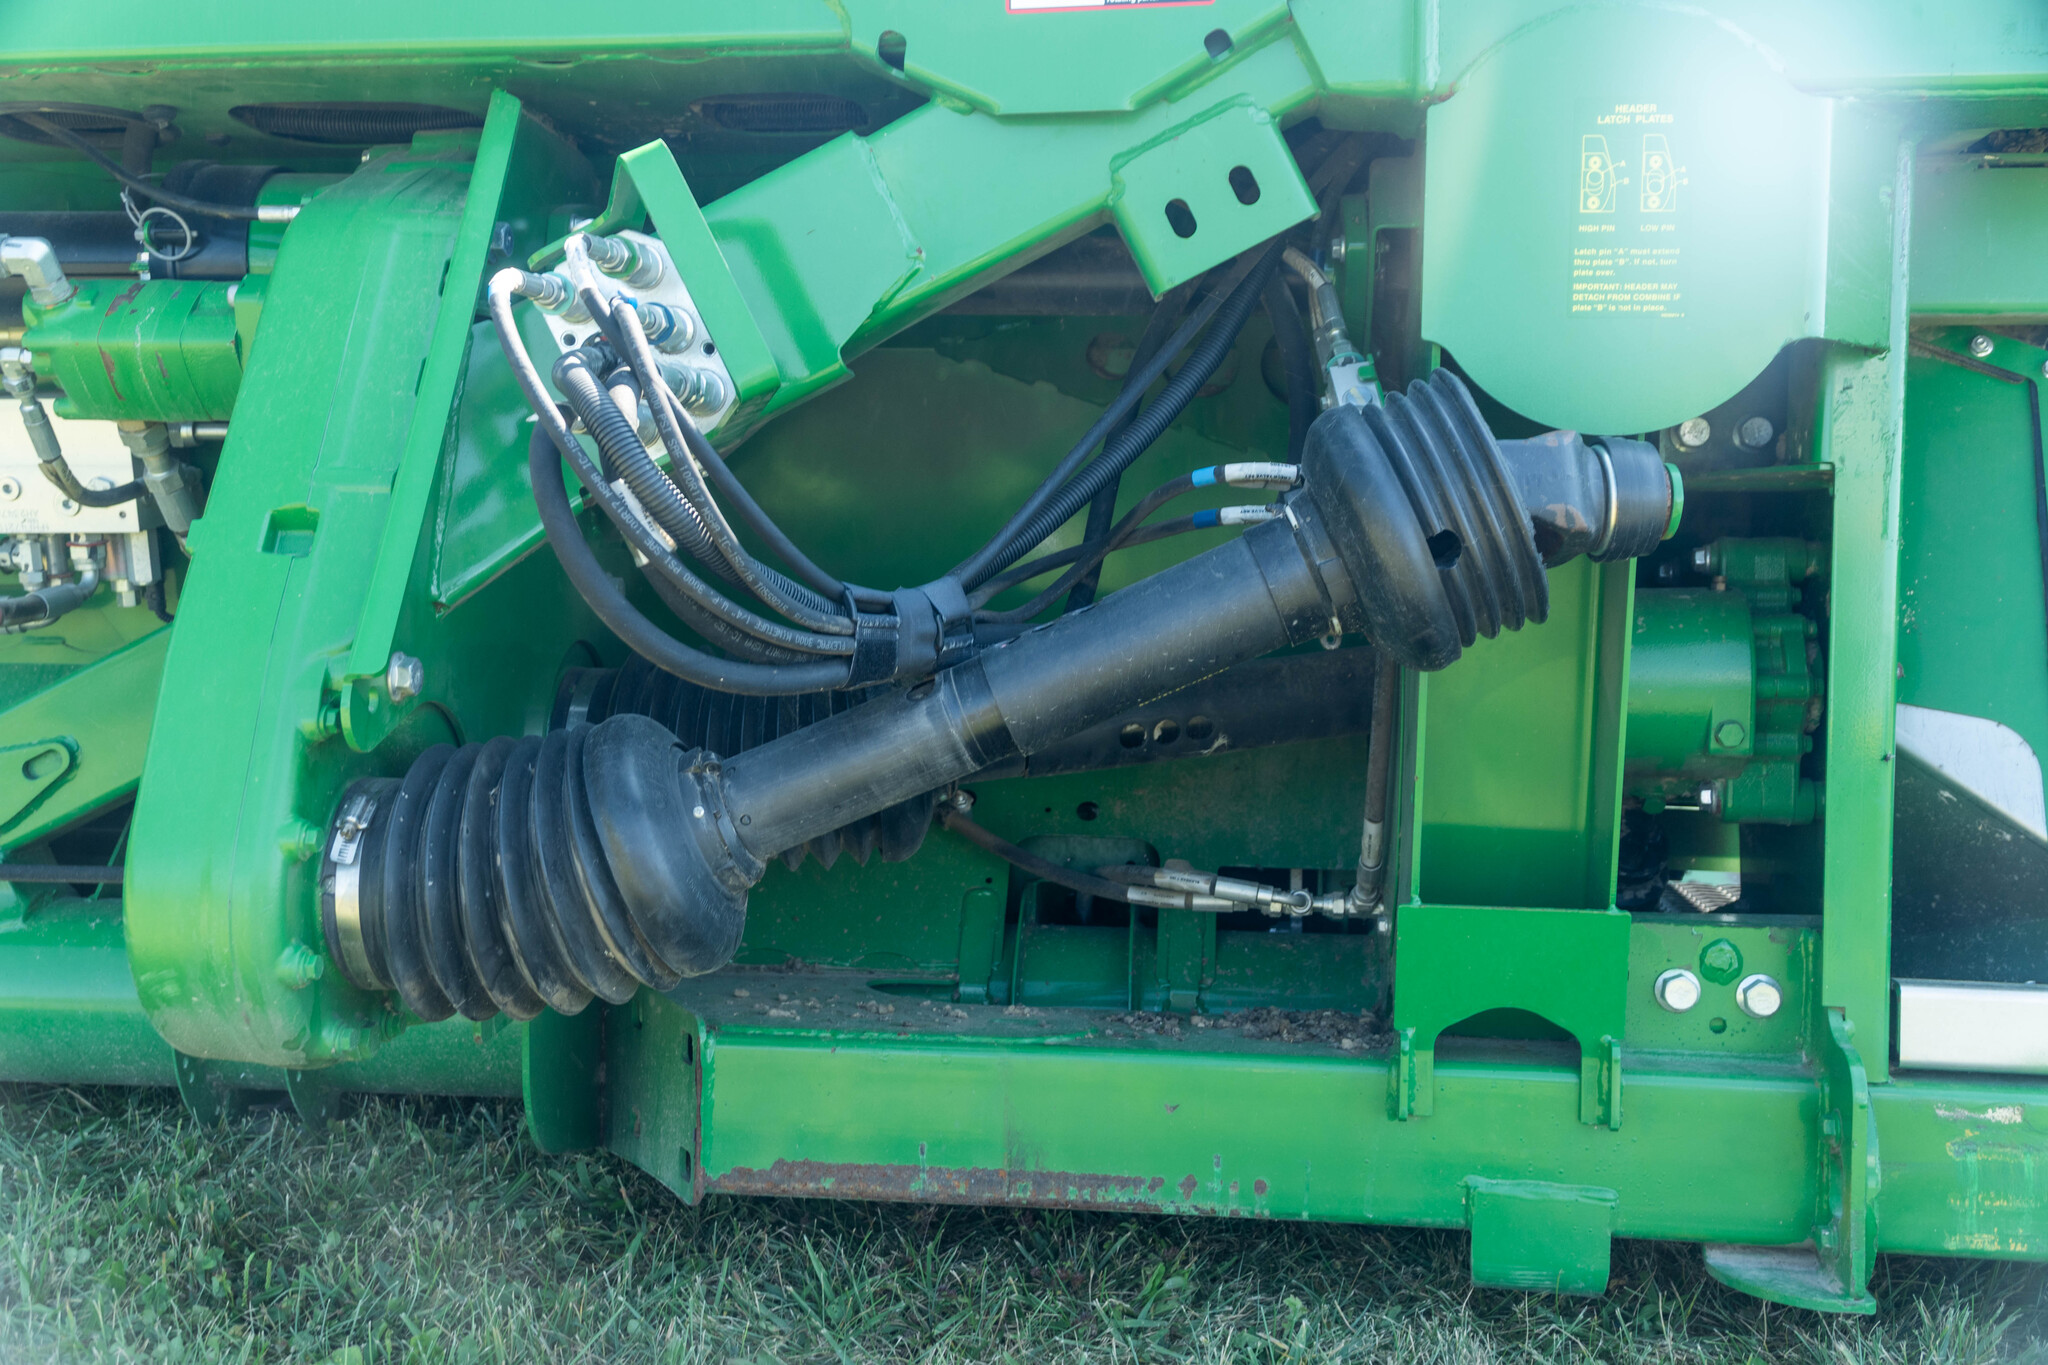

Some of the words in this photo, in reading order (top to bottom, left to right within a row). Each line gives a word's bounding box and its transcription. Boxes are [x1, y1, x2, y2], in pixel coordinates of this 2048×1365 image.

[1615, 104, 1657, 113] HEADER
[1597, 115, 1630, 124] LATCH
[1635, 114, 1674, 124] PLATES
[1578, 224, 1599, 232] HIGH
[1601, 224, 1615, 232] PIN
[1640, 224, 1659, 232] LOW
[1660, 224, 1676, 232] PIN
[1574, 247, 1597, 255] Latch
[1598, 247, 1612, 257] pin
[1652, 247, 1681, 255] extend
[1573, 258, 1591, 266] thru
[1592, 258, 1613, 267] plate
[1633, 258, 1640, 266] If
[1660, 258, 1678, 266] turn
[1573, 269, 1594, 277] plate
[1572, 283, 1621, 291] IMPORTANT:
[1572, 293, 1605, 301] DETACH
[1606, 293, 1631, 301] FROM
[1633, 293, 1671, 301] COMBINE
[1572, 304, 1592, 312] plate
[1642, 304, 1667, 312] place.
[657, 412, 672, 433] PSI
[667, 437, 683, 459] SAE
[680, 464, 705, 502] 100R17
[701, 506, 721, 532] MSHA
[590, 471, 613, 498] MSHA
[611, 501, 642, 534] 100R17
[644, 537, 662, 556] SAE
[664, 555, 681, 575] PSI
[682, 573, 706, 594] 3000
[795, 635, 814, 647] 3000
[817, 639, 846, 651] FLEXPAC
